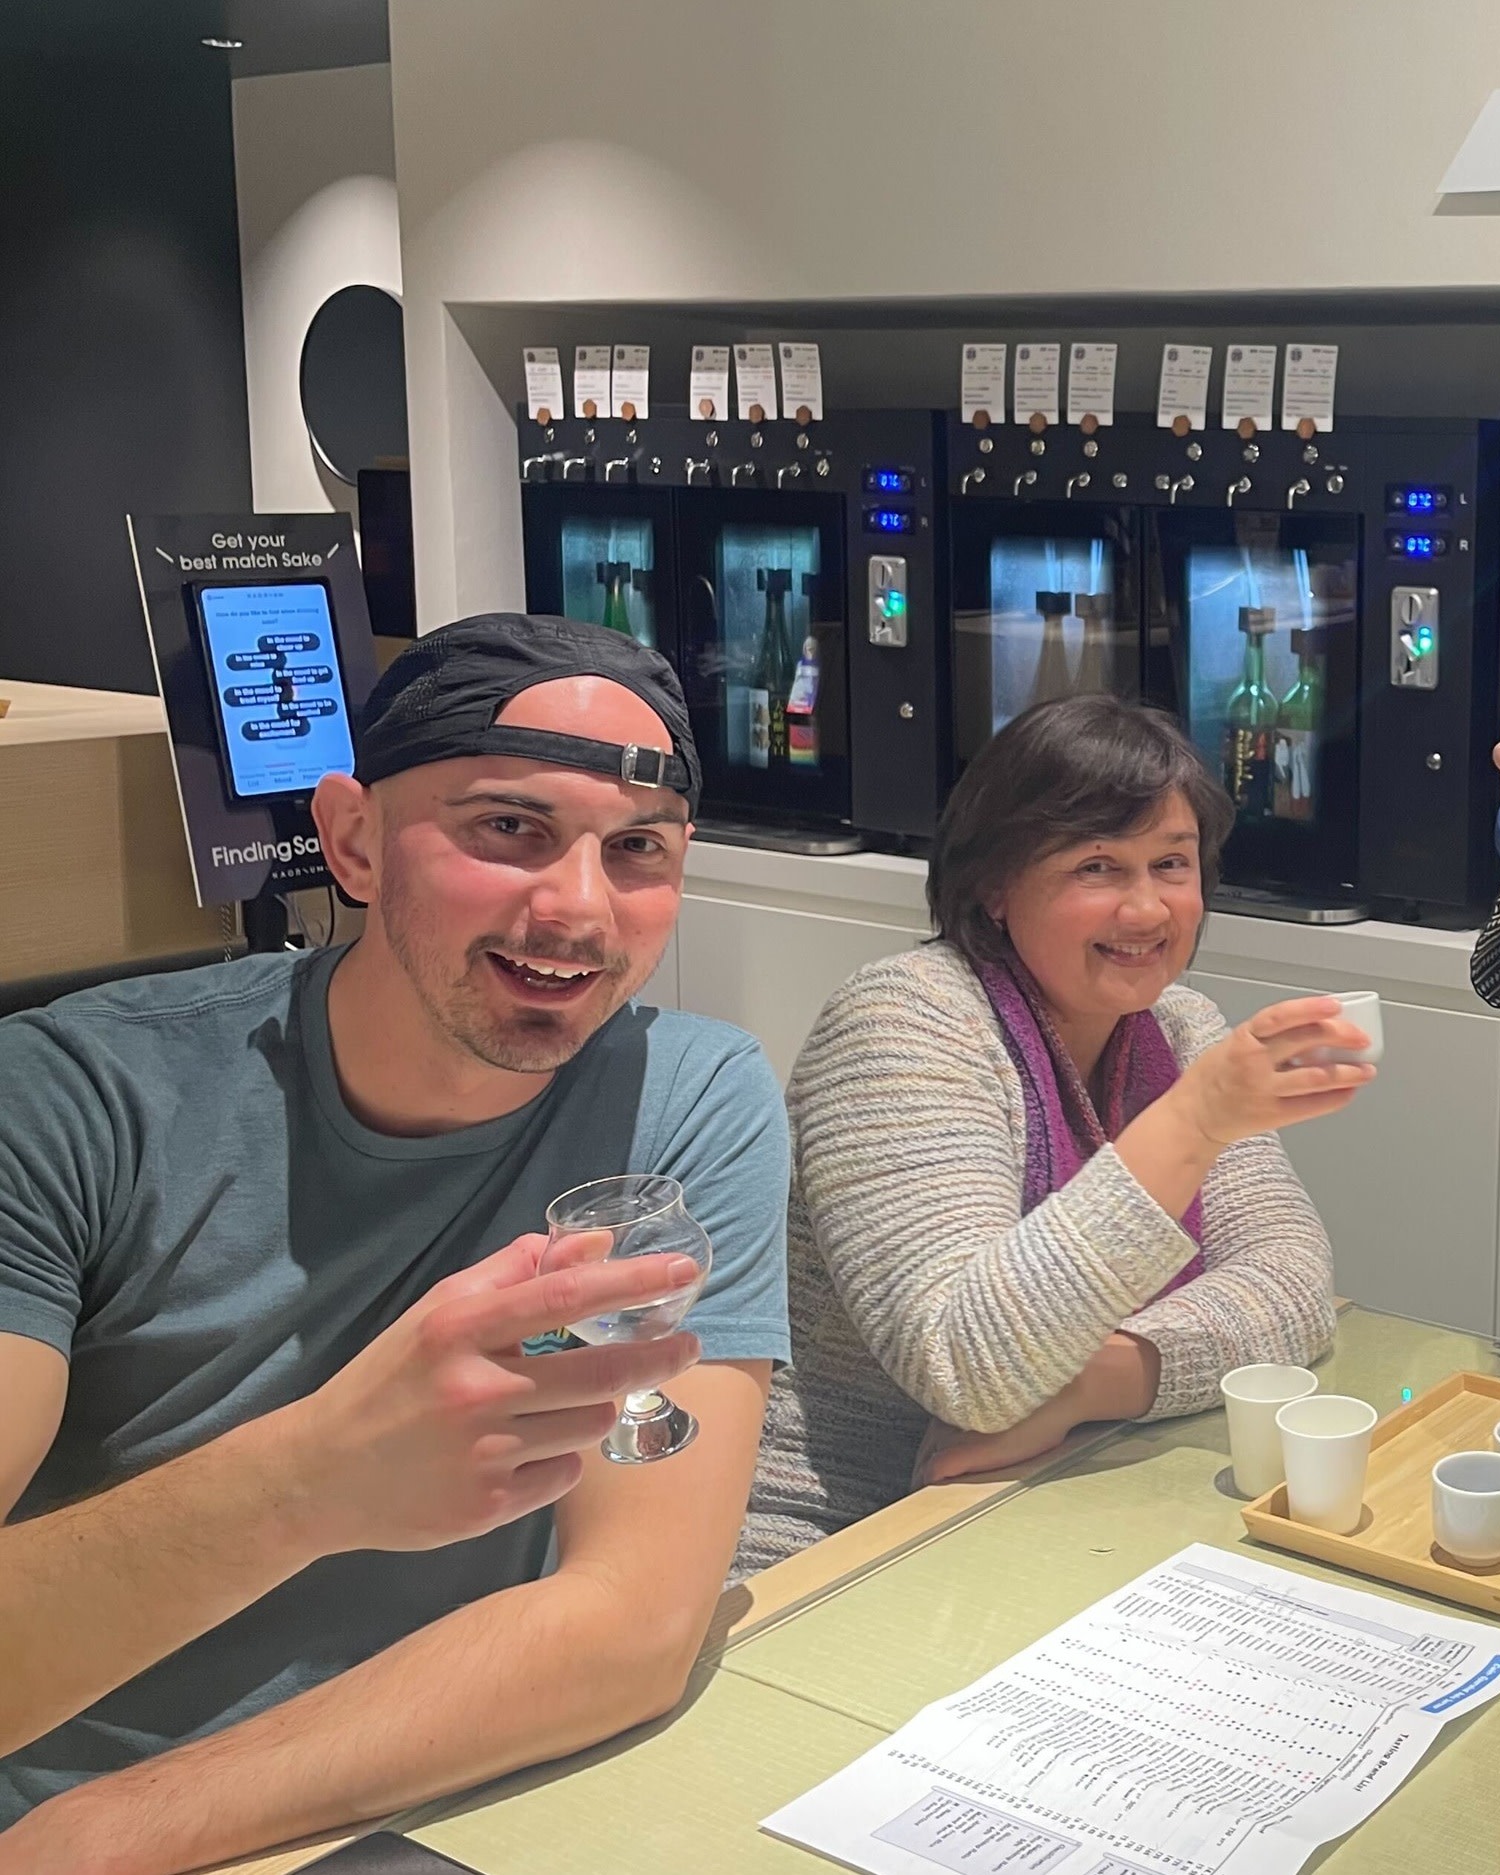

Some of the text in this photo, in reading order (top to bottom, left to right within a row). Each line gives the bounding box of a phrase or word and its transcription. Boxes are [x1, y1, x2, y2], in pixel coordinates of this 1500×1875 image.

[1460, 493, 1468, 505] L
[211, 532, 286, 551] Get your
[1459, 539, 1469, 551] R
[179, 551, 322, 571] best match Sake
[211, 834, 321, 868] FindingSa
[1353, 1733, 1410, 1792] Tasting Brand List
